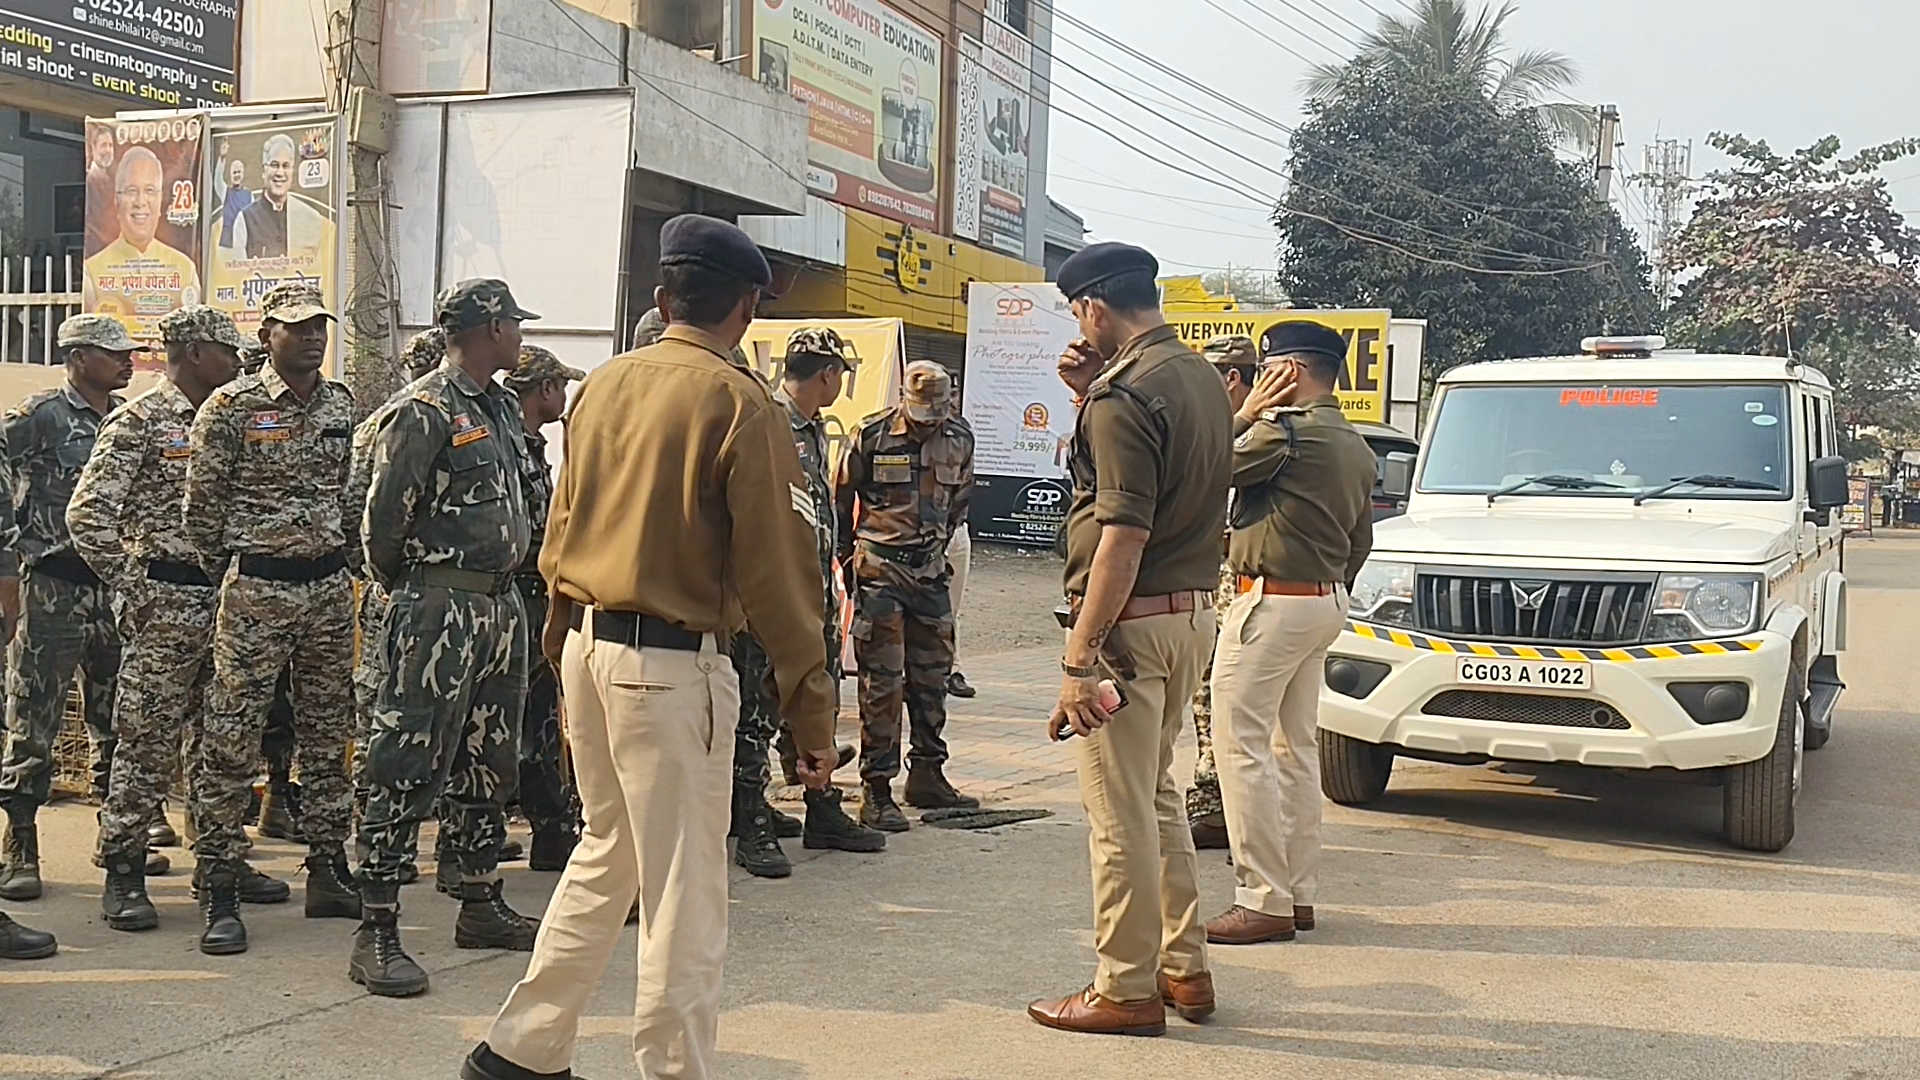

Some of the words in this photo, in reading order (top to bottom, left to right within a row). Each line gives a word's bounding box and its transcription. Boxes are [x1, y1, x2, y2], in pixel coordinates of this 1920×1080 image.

[171, 0, 236, 20] OGRAPHY
[89, 13, 204, 54] shine.bhilai12@gmail.com
[793, 7, 809, 25] DCA
[815, 18, 839, 40] PGDCA
[826, 0, 880, 37] COMPUTER
[884, 22, 935, 66] EDUCATION
[998, 30, 1025, 62] ADITI
[832, 47, 850, 66] DATA
[27, 55, 74, 80] shoot
[140, 83, 181, 105] shoot
[307, 162, 321, 176] 23
[174, 184, 193, 209] 23
[122, 272, 142, 294] भूपेश
[169, 272, 180, 289] जी
[997, 298, 1033, 316] SDP
[973, 345, 1056, 365] Photographer
[1560, 388, 1659, 406] POLICE
[1013, 441, 1055, 453] 29,999/-
[1027, 488, 1061, 505] SDP
[1461, 663, 1512, 681] CG03
[1518, 666, 1531, 682] A
[1538, 667, 1584, 684] 1022
